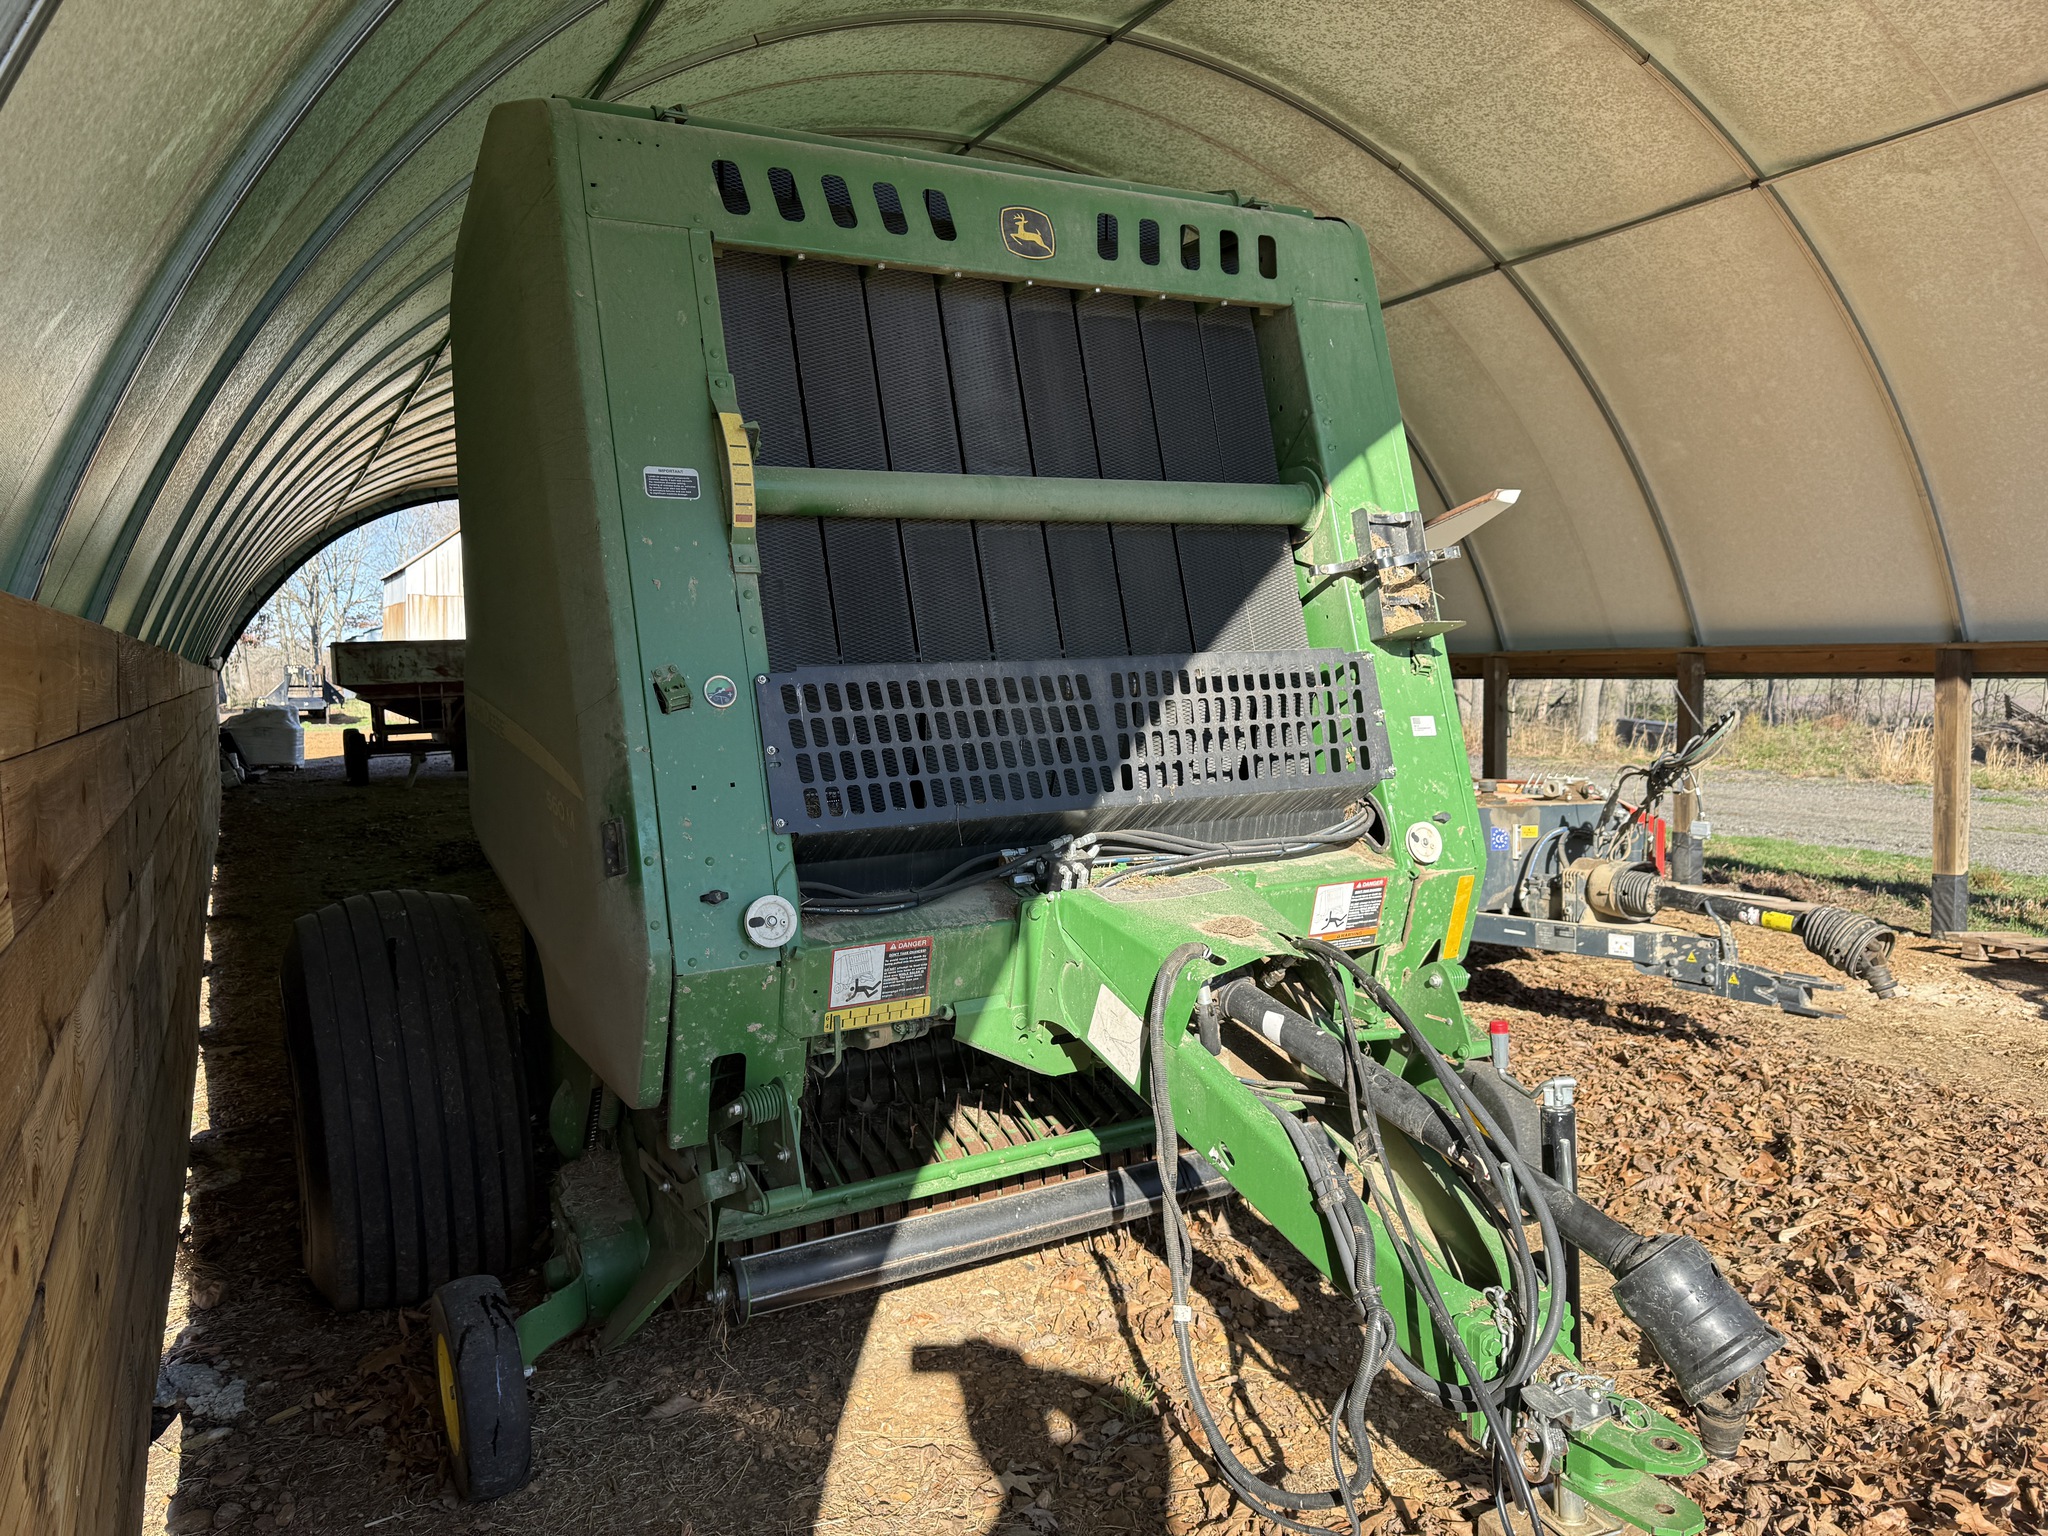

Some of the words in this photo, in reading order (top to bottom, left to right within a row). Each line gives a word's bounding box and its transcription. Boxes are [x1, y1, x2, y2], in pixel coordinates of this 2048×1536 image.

[1495, 834, 1505, 844] CE
[1362, 879, 1384, 888] DANGER
[898, 939, 927, 949] DANGER
